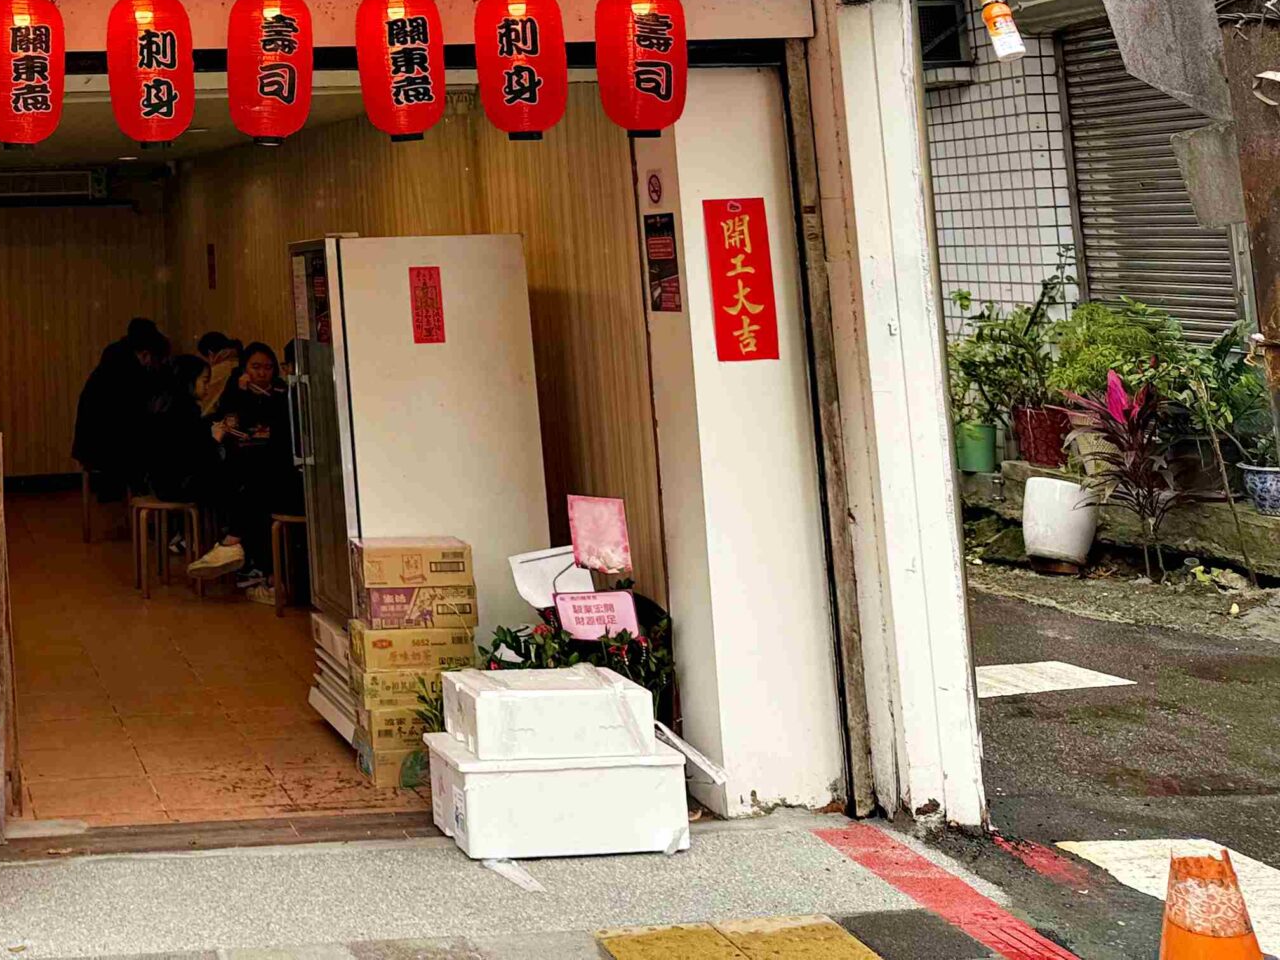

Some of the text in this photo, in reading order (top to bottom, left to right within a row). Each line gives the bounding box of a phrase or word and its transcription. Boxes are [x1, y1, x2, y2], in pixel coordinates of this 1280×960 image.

[9, 23, 52, 113] 關東煮
[138, 29, 179, 119] 刺身
[256, 14, 300, 106] 壽司
[386, 16, 435, 106] 關東煮
[496, 16, 543, 106] 刺身
[633, 12, 674, 103] 壽司
[719, 213, 764, 357] 開工大吉
